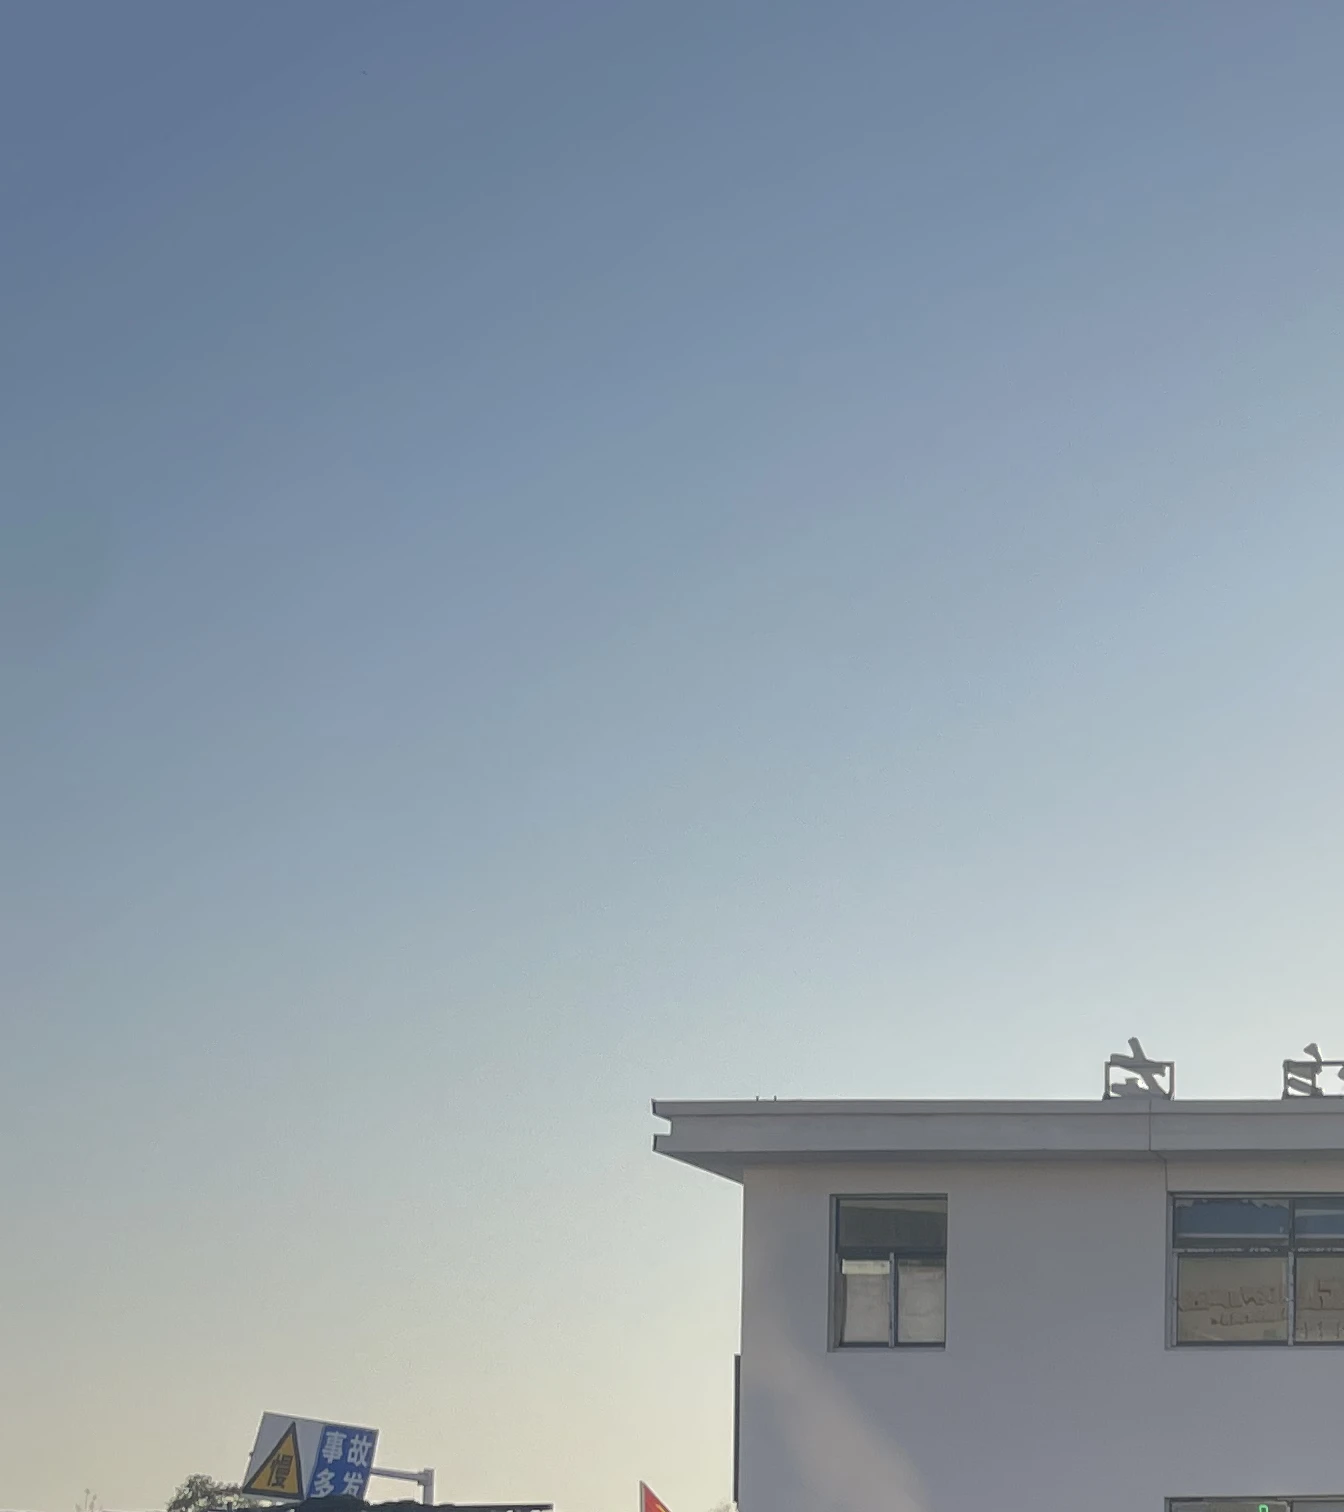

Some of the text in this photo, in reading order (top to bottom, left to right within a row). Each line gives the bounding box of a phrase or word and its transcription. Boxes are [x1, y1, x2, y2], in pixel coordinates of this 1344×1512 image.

[322, 1431, 373, 1468] 事故
[267, 1453, 294, 1489] 慢
[311, 1468, 363, 1499] 多发
